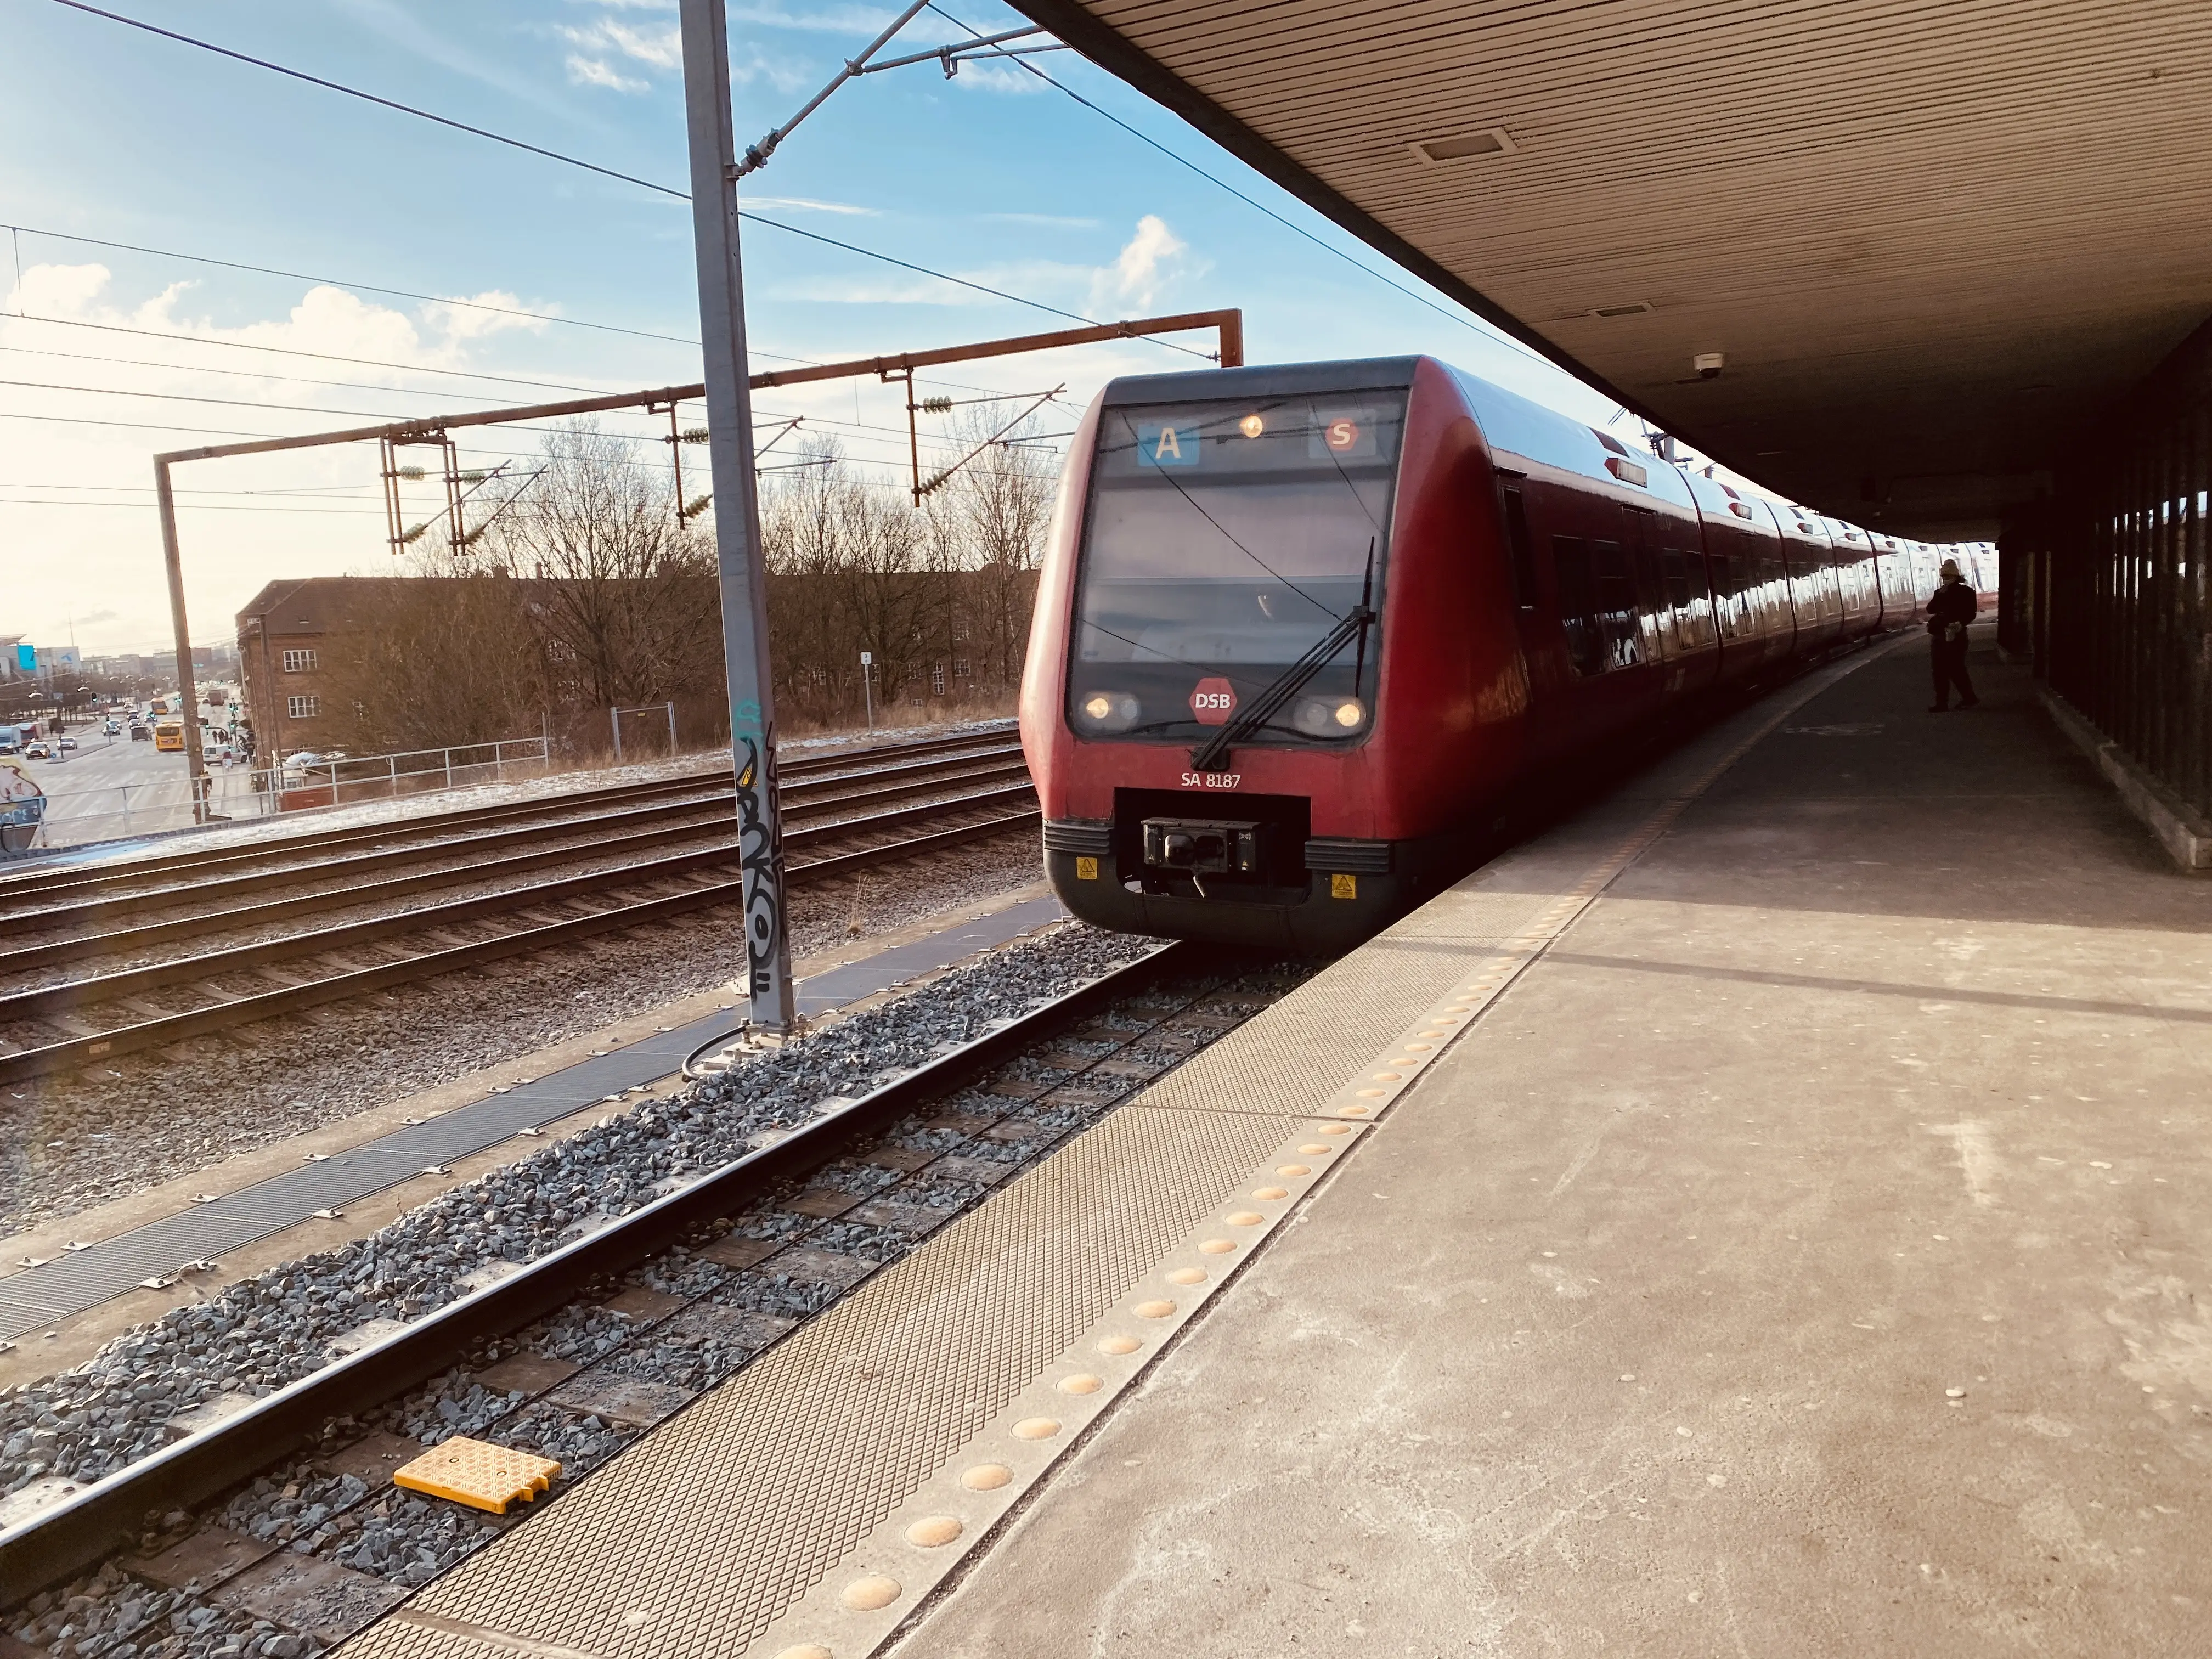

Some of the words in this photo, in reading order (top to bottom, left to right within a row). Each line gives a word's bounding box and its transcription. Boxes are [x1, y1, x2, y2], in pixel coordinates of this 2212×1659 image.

[1155, 427, 1181, 459] A
[1333, 424, 1351, 445] S
[1195, 693, 1231, 708] DSB
[1181, 772, 1201, 787] SA
[1206, 774, 1241, 788] 8187
